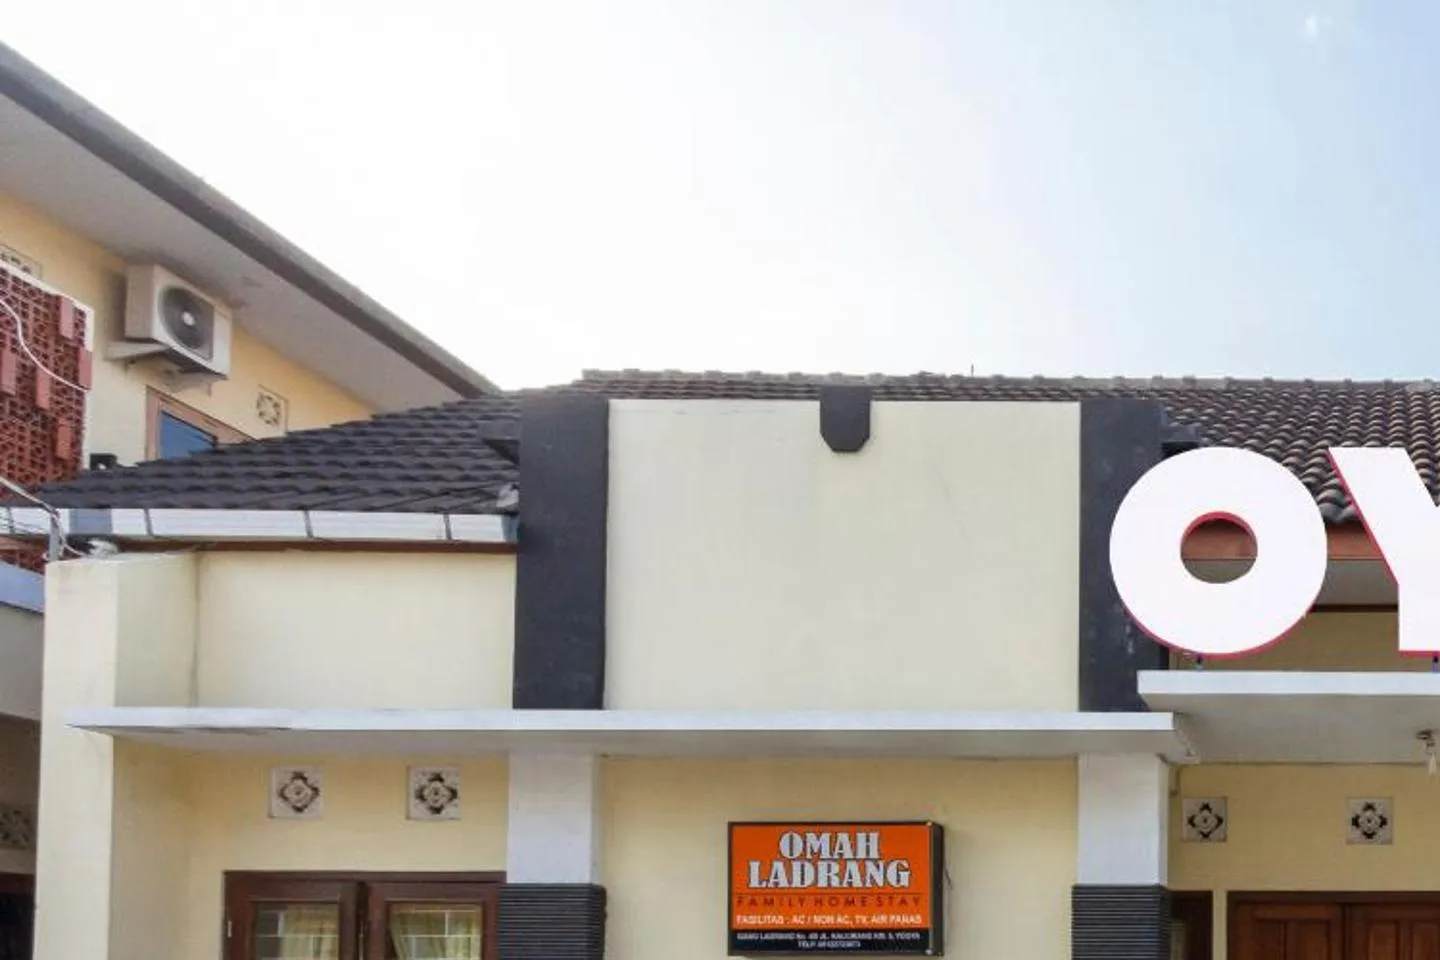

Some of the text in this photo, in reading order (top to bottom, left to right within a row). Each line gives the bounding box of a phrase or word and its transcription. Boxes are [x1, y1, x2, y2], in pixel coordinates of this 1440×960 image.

[779, 831, 881, 859] OMAH
[748, 859, 911, 888] LADRANG
[736, 896, 805, 908] FAMILY
